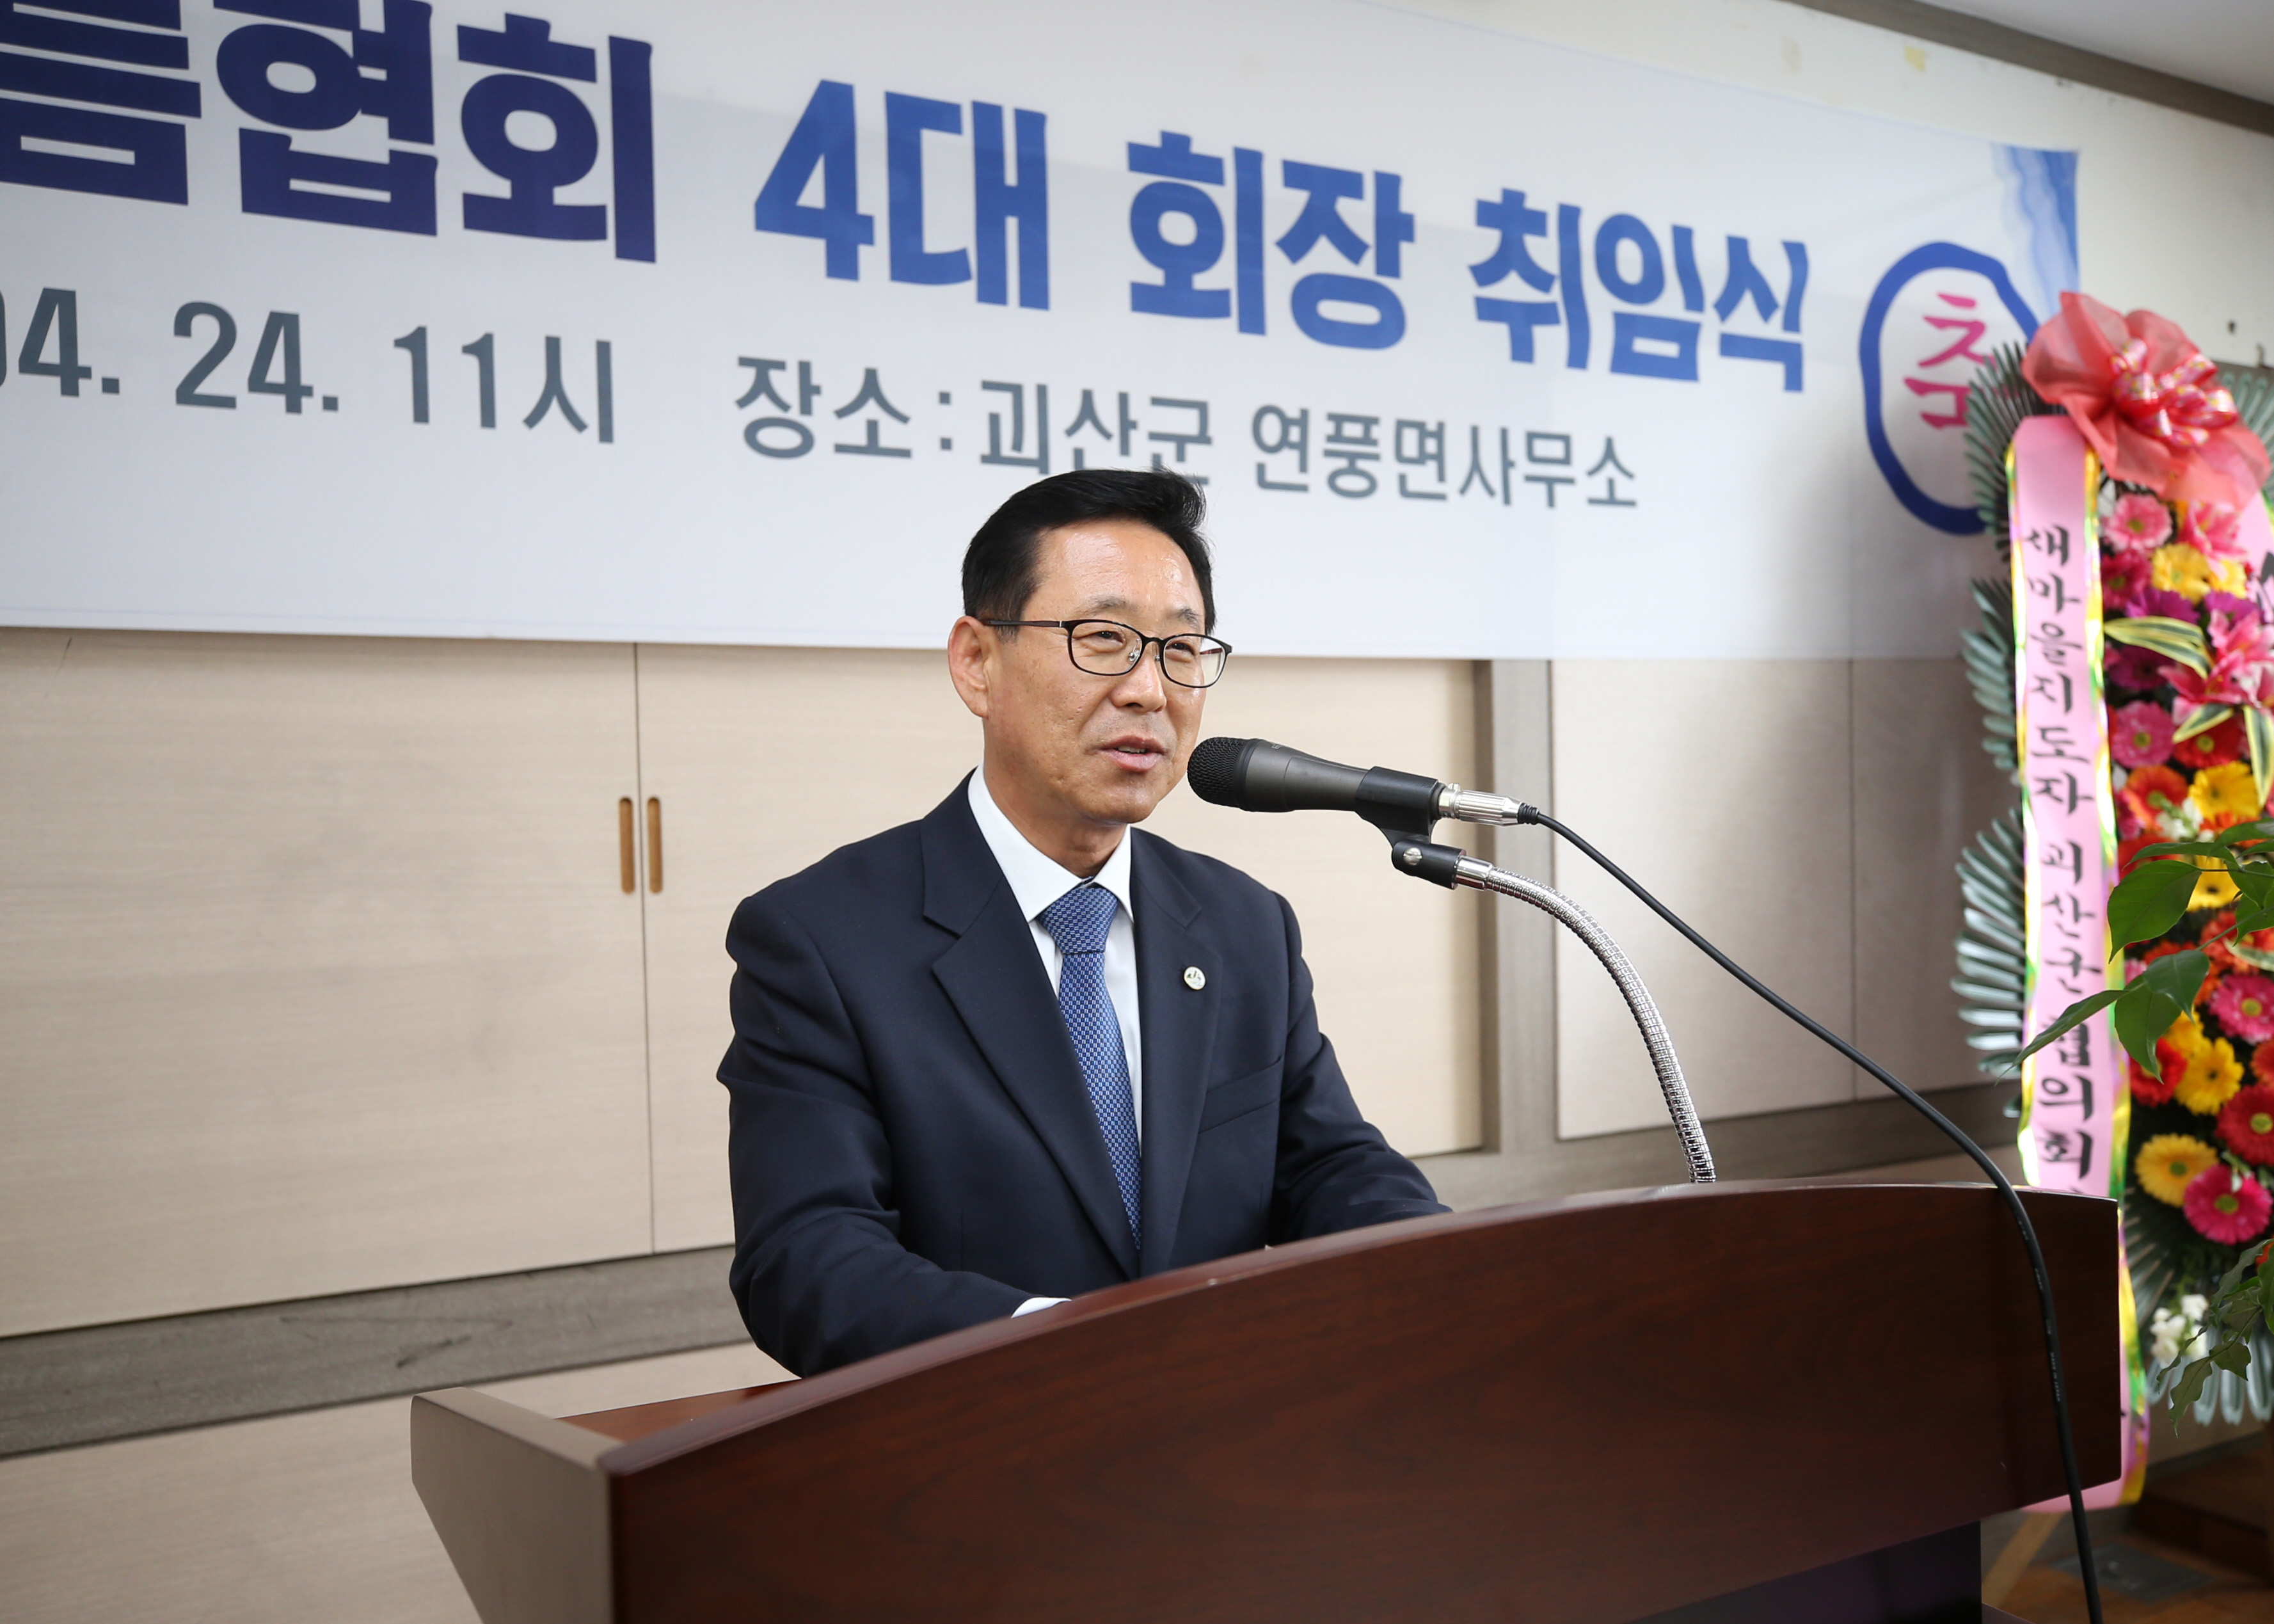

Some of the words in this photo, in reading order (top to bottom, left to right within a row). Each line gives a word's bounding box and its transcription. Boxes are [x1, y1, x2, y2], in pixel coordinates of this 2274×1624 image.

[754, 79, 1051, 311] 4대
[1126, 130, 1415, 351] 회장
[1467, 187, 1809, 393] 취임식
[0, 287, 120, 397] 4.
[173, 301, 339, 415] 24.
[394, 326, 614, 443] 11시
[1251, 404, 1638, 509] 연풍면사무소
